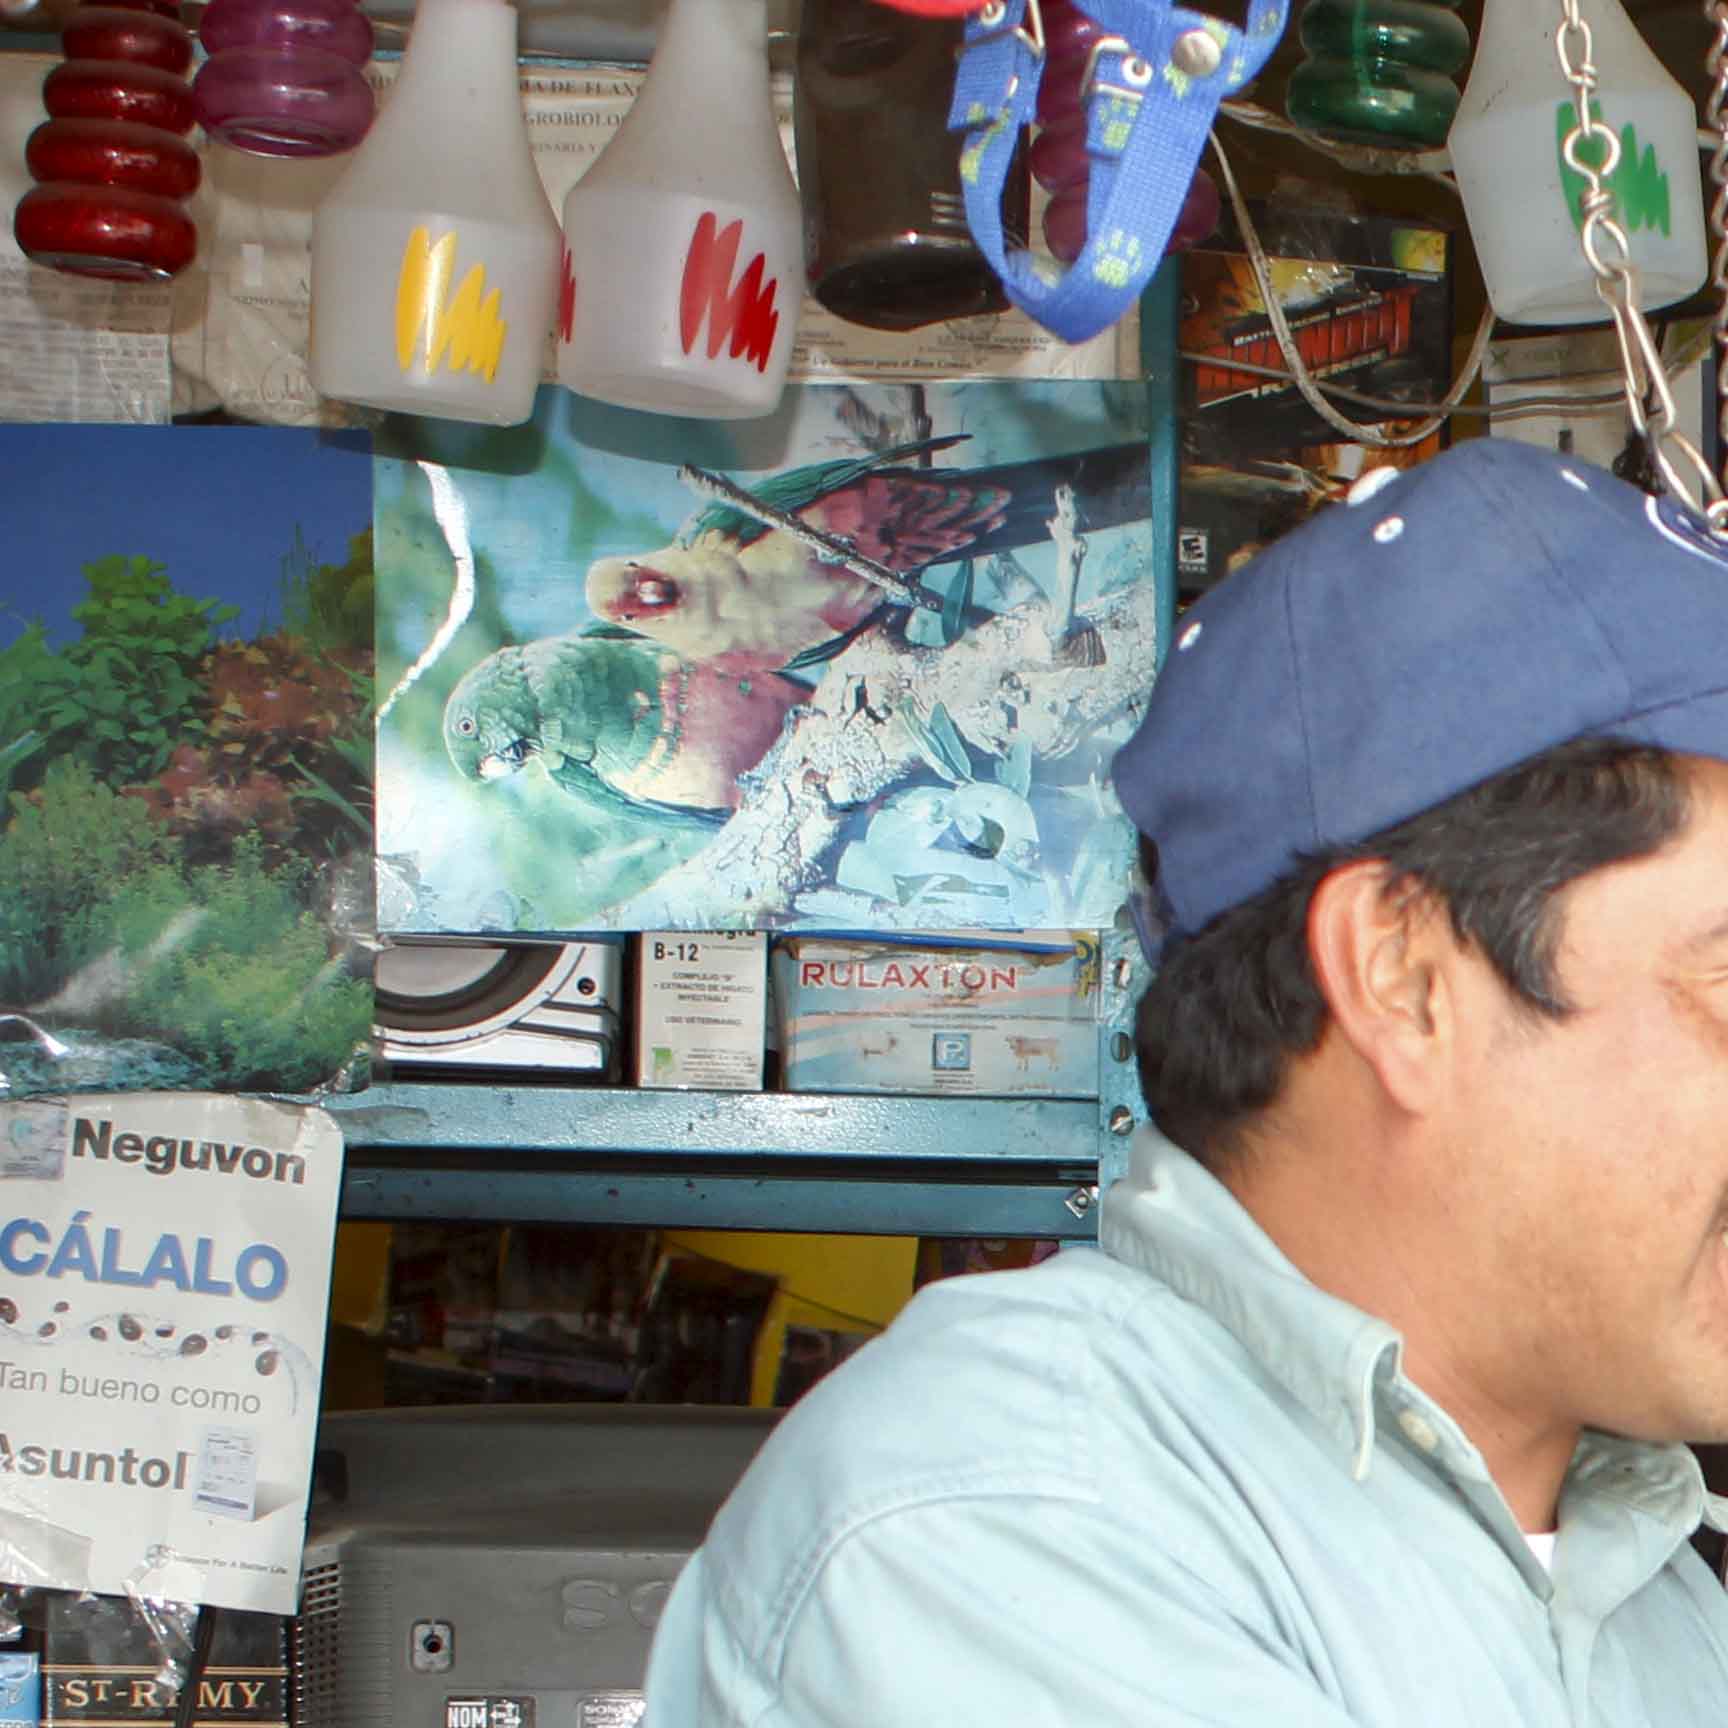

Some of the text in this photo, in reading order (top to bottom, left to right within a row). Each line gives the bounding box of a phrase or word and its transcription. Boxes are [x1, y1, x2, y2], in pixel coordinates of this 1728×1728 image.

[654, 941, 699, 961] B-12
[801, 961, 1017, 992] RULAXTON
[72, 1117, 306, 1186] Neguvon
[0, 1210, 289, 1303] CÁLALO
[0, 1361, 261, 1416] Tan bueno como
[448, 1706, 487, 1728] NOM
